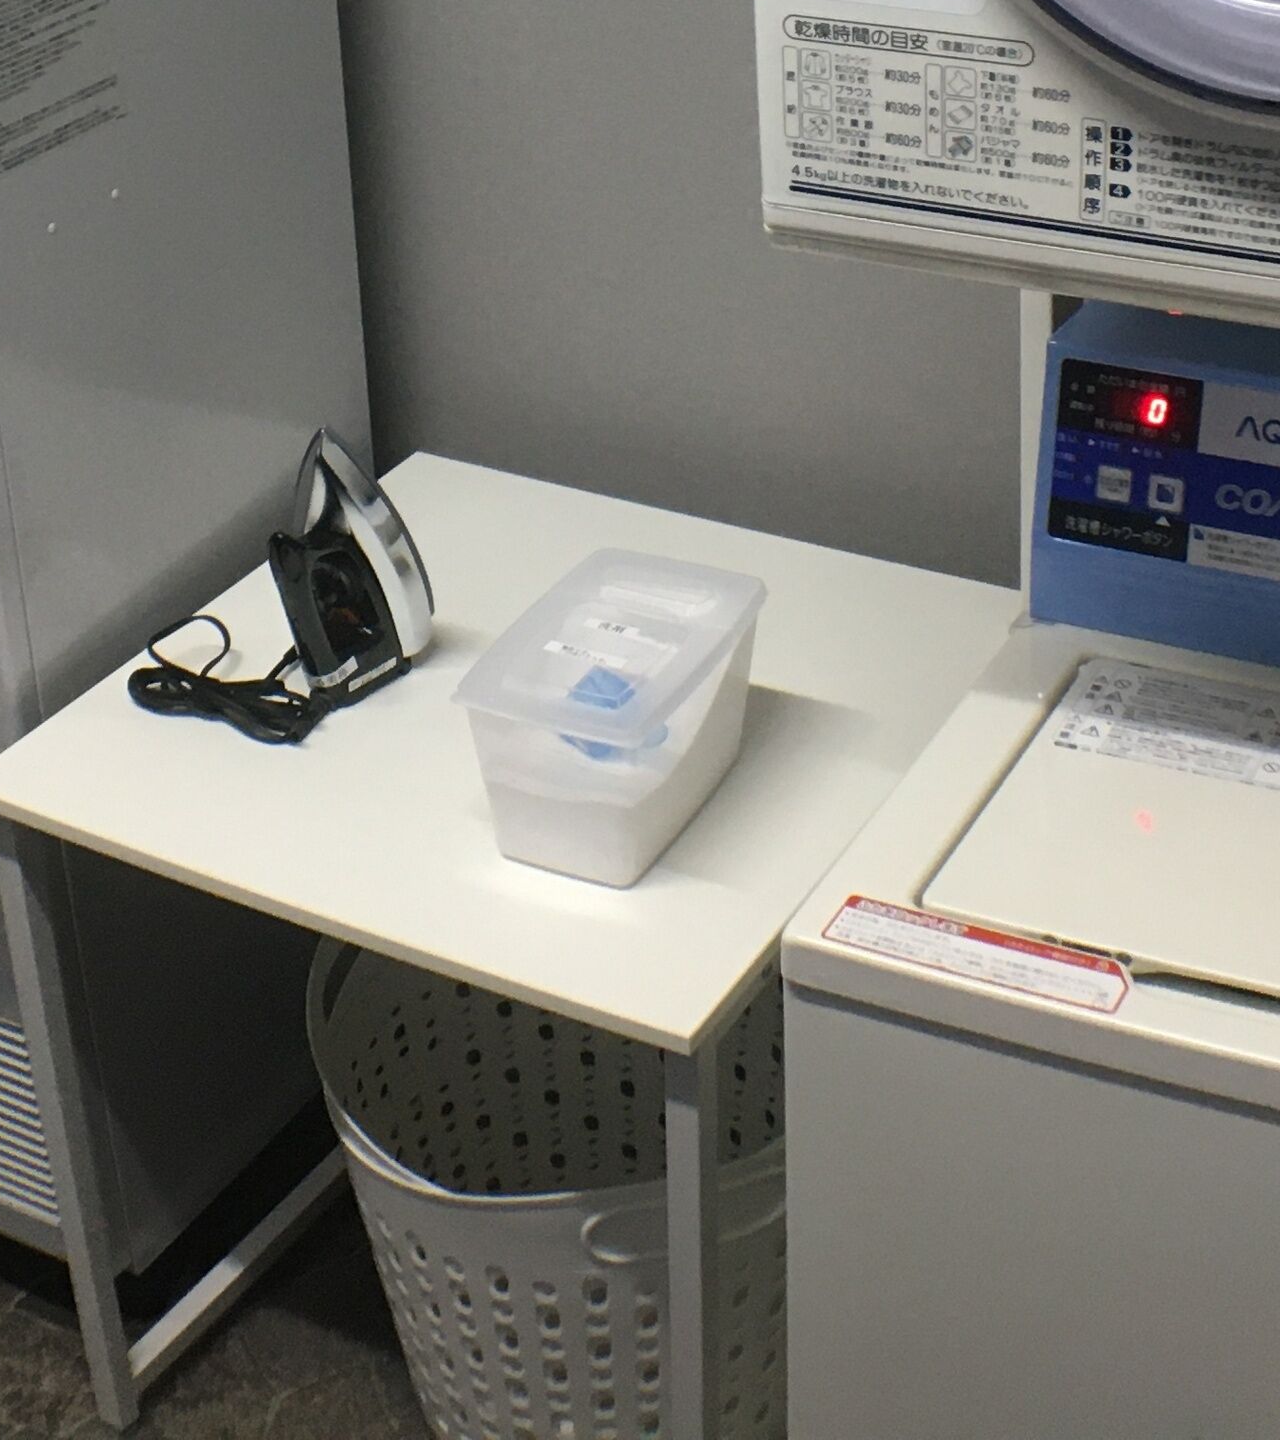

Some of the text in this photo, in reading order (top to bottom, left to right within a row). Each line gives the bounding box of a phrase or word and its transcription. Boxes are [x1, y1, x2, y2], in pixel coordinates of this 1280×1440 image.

[794, 19, 929, 51] 乾燥時間の目安
[791, 162, 1030, 210] 45kg以上の洗濯物を入れないでください。
[1147, 398, 1168, 424] 0
